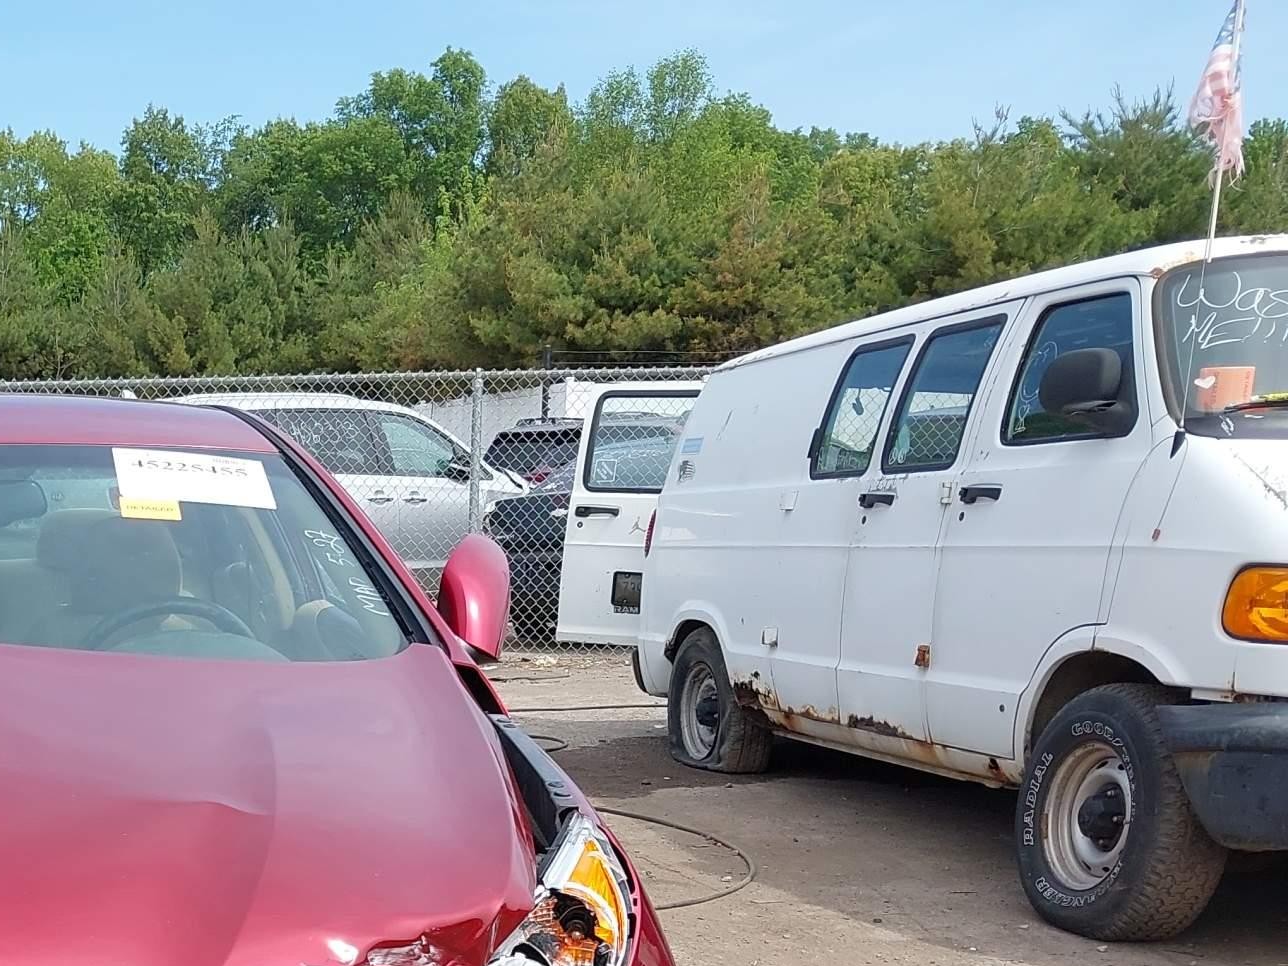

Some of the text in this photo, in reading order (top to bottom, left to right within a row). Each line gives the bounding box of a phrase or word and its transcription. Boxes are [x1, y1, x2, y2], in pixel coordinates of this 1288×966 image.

[131, 459, 248, 477] 45225455
[614, 605, 639, 614] RAM
[1023, 751, 1055, 846] RADIAL
